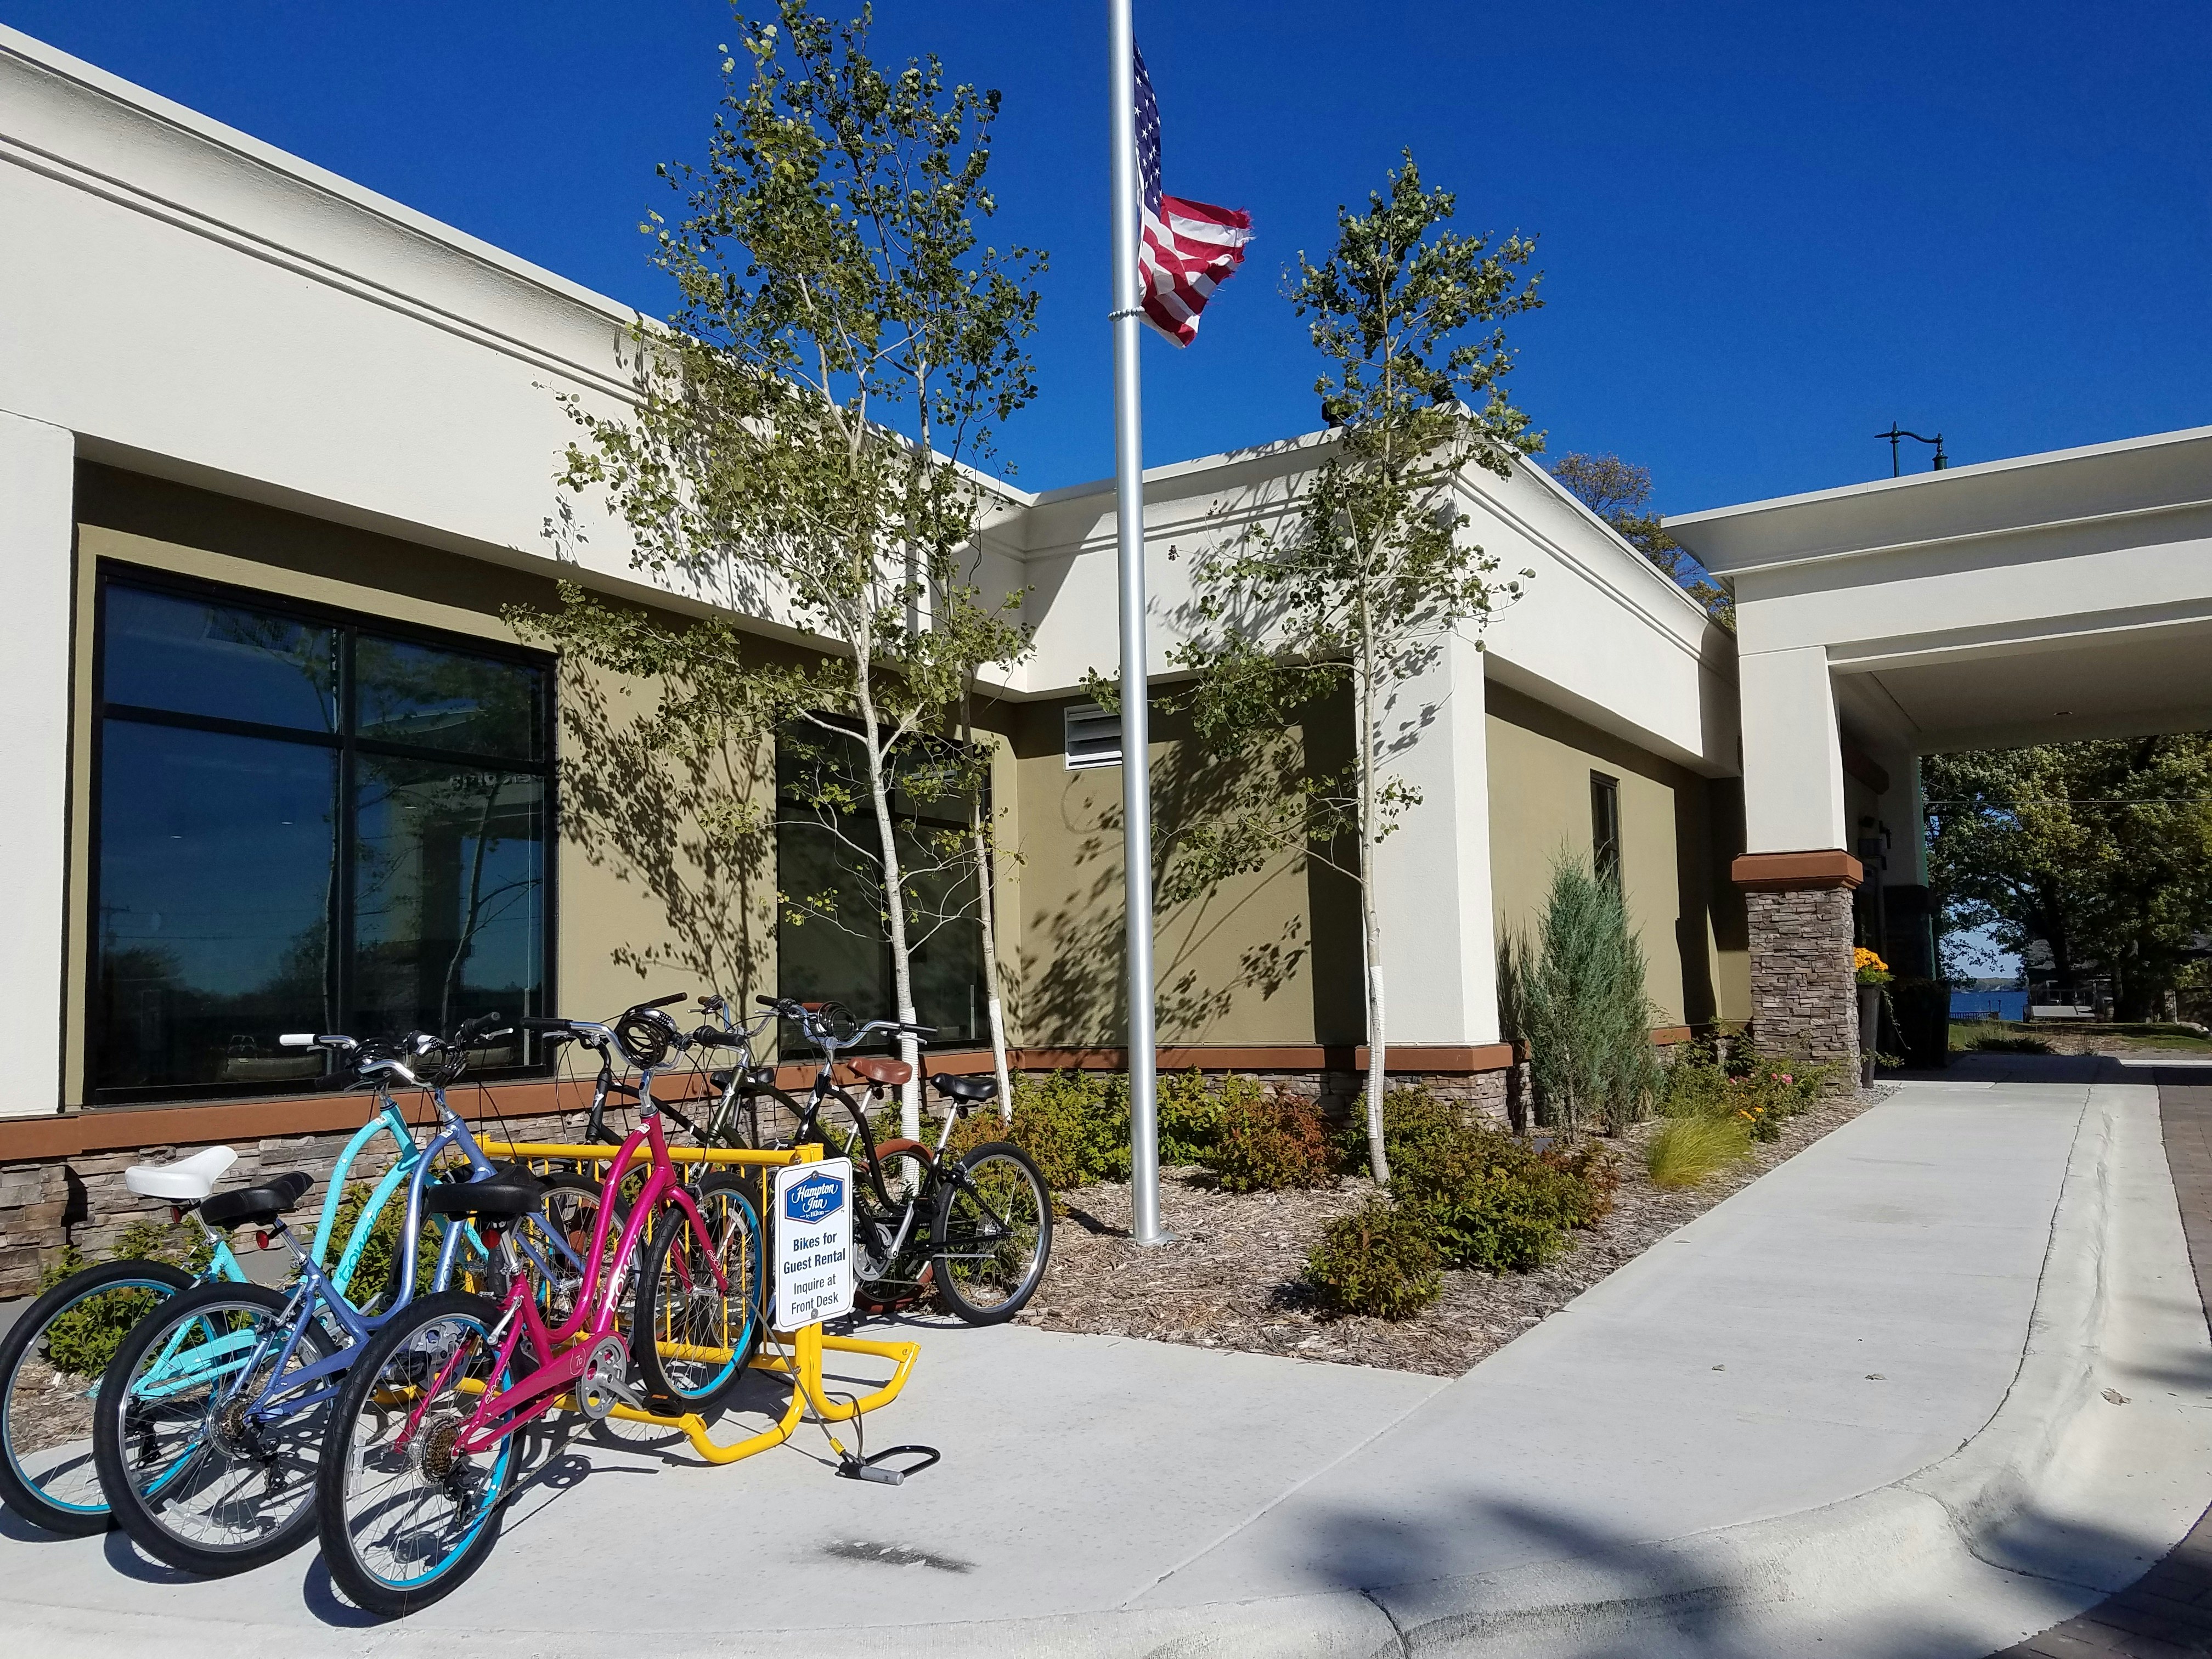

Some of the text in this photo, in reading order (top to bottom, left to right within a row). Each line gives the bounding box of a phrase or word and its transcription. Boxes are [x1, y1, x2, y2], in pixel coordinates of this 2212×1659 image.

[792, 1183, 838, 1204] Hampton
[803, 1197, 827, 1213] Inn
[793, 1232, 837, 1252] Bikes for
[784, 1248, 845, 1274] Guest Rental
[794, 1274, 836, 1295] Inquire at
[792, 1292, 838, 1314] Front Desk
